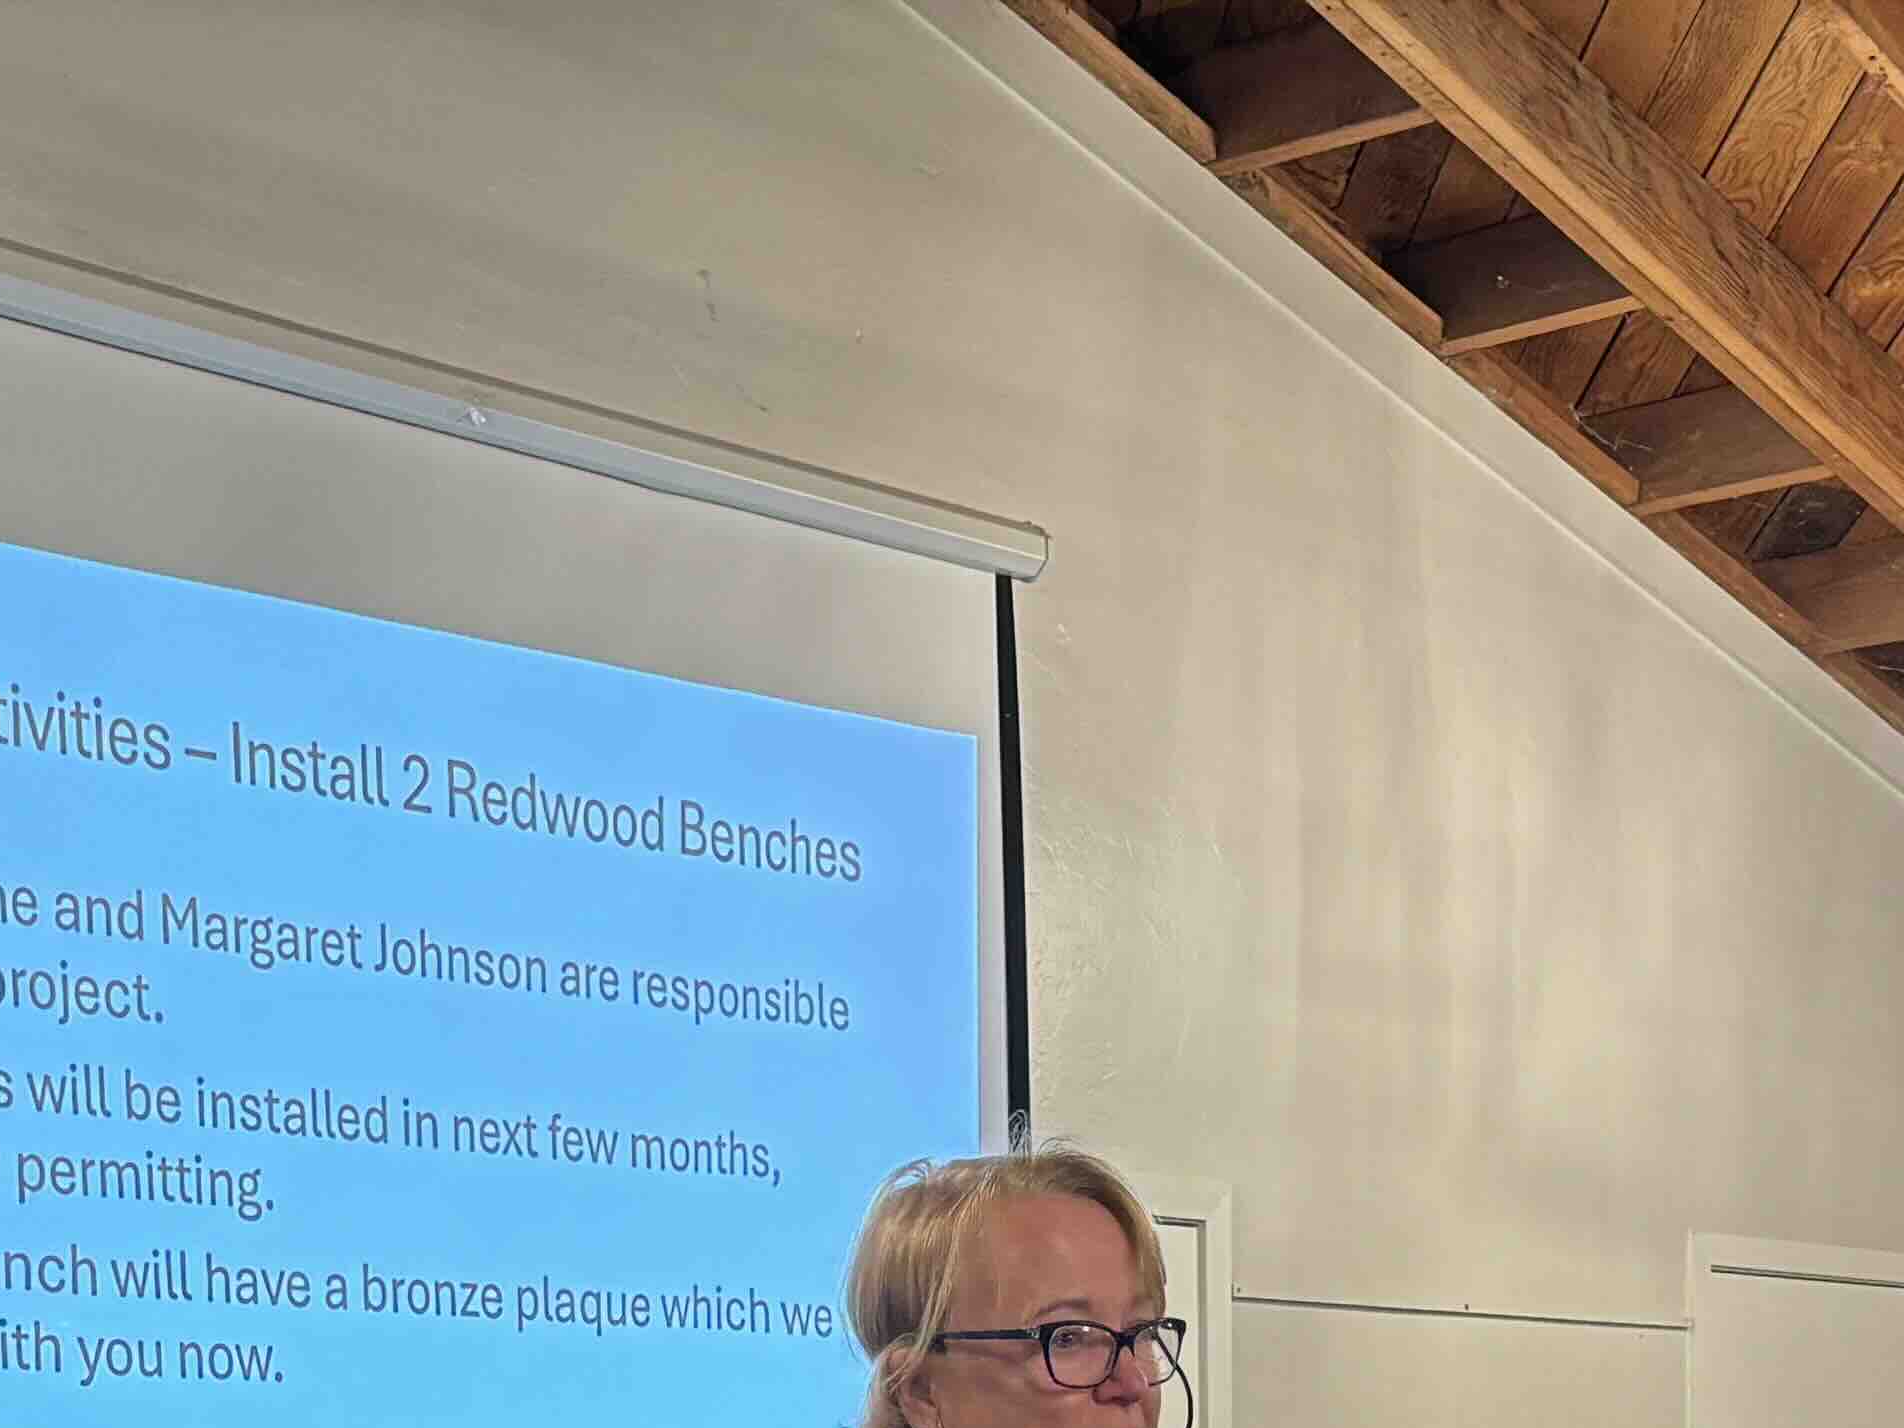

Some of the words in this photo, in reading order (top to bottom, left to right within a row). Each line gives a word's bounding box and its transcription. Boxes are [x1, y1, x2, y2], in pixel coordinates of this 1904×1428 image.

[230, 719, 391, 809] Install
[401, 752, 434, 815] 2
[446, 757, 666, 854] Redwood
[679, 798, 862, 883] Benches
[53, 887, 146, 943] and
[160, 892, 364, 972] Margaret
[372, 921, 548, 995] Johnson
[558, 960, 621, 1003] are
[631, 968, 850, 1032] responsible
[25, 1062, 113, 1119] will
[123, 1066, 183, 1125] be
[195, 1075, 390, 1146] installed
[401, 1096, 440, 1151] in
[452, 1113, 540, 1160] next
[546, 1111, 620, 1166] few
[630, 1128, 781, 1189] months,
[16, 1148, 275, 1223] permitting.
[109, 1247, 194, 1303] will
[204, 1250, 312, 1310] have
[323, 1272, 349, 1312] a
[361, 1262, 505, 1321] bronze
[516, 1274, 652, 1338] plaque
[659, 1282, 772, 1335] which
[778, 1300, 834, 1340] we
[75, 1335, 164, 1388] you
[178, 1340, 284, 1385] now.
